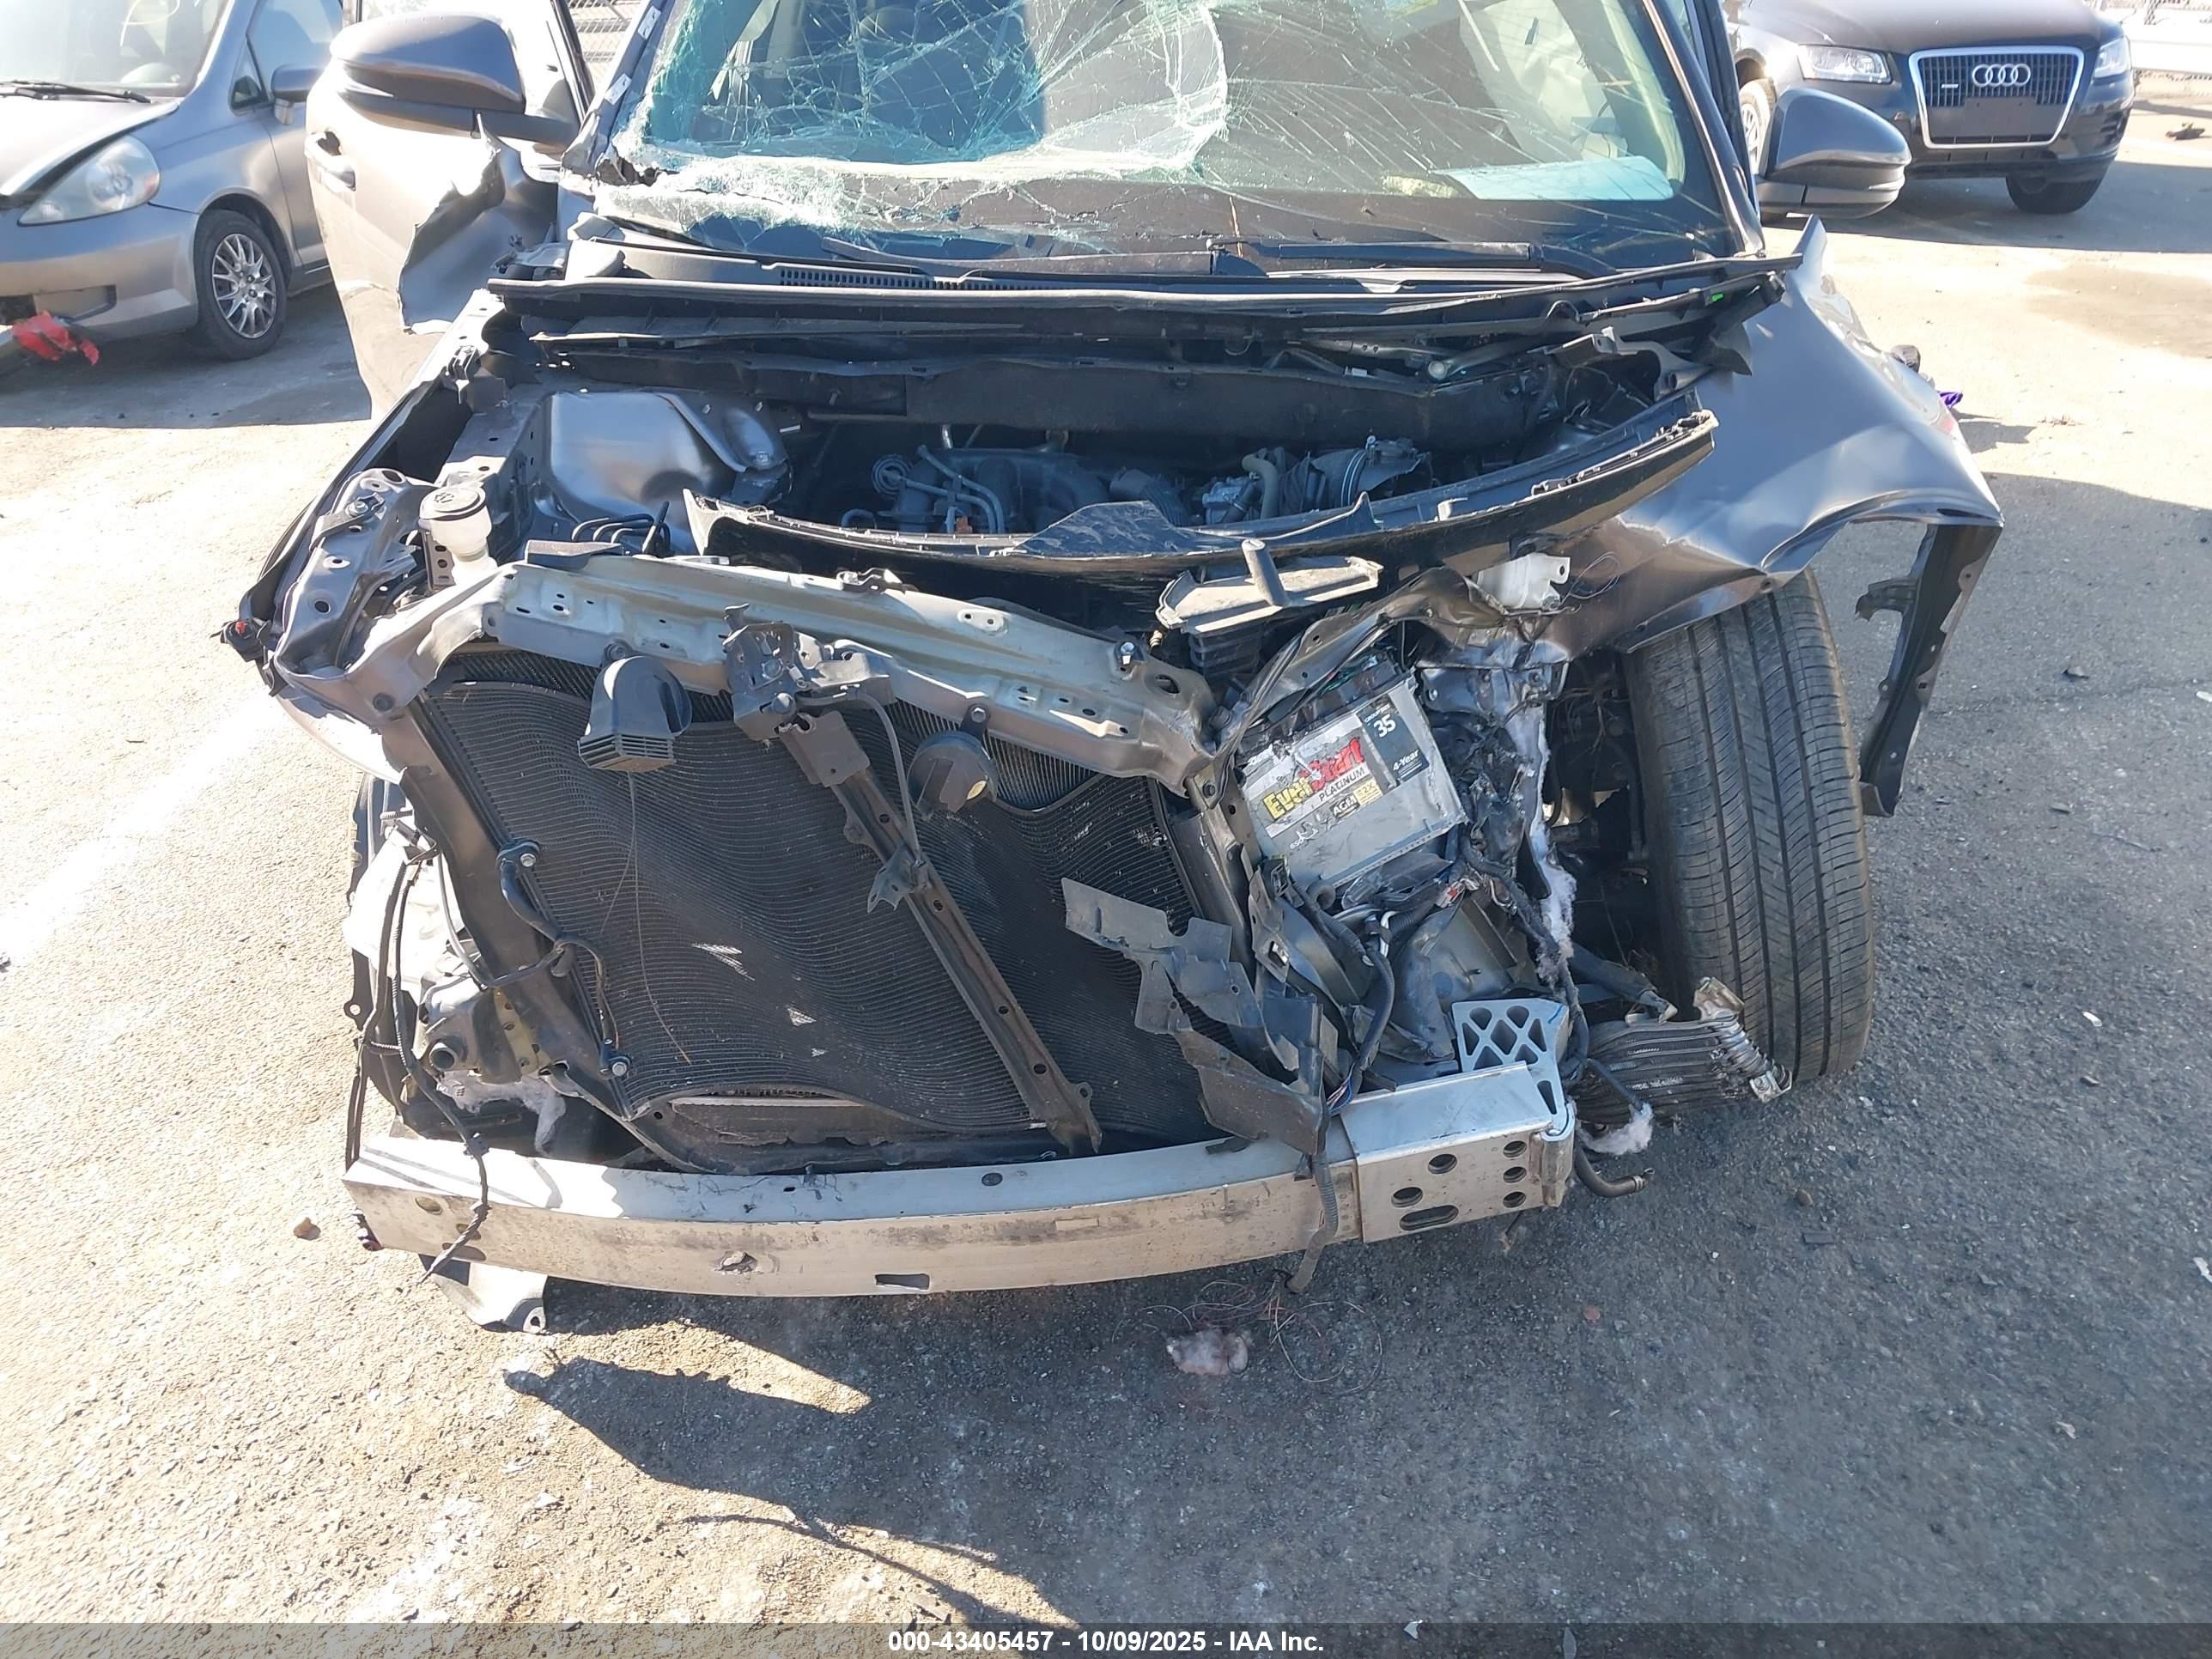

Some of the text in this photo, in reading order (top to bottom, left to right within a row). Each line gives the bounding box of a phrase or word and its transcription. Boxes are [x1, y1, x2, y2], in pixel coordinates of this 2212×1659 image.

[1373, 714, 1396, 738] 35
[1393, 749, 1419, 771] 4-Year
[1318, 767, 1366, 802] PLATINUM
[1332, 793, 1358, 817] AGM
